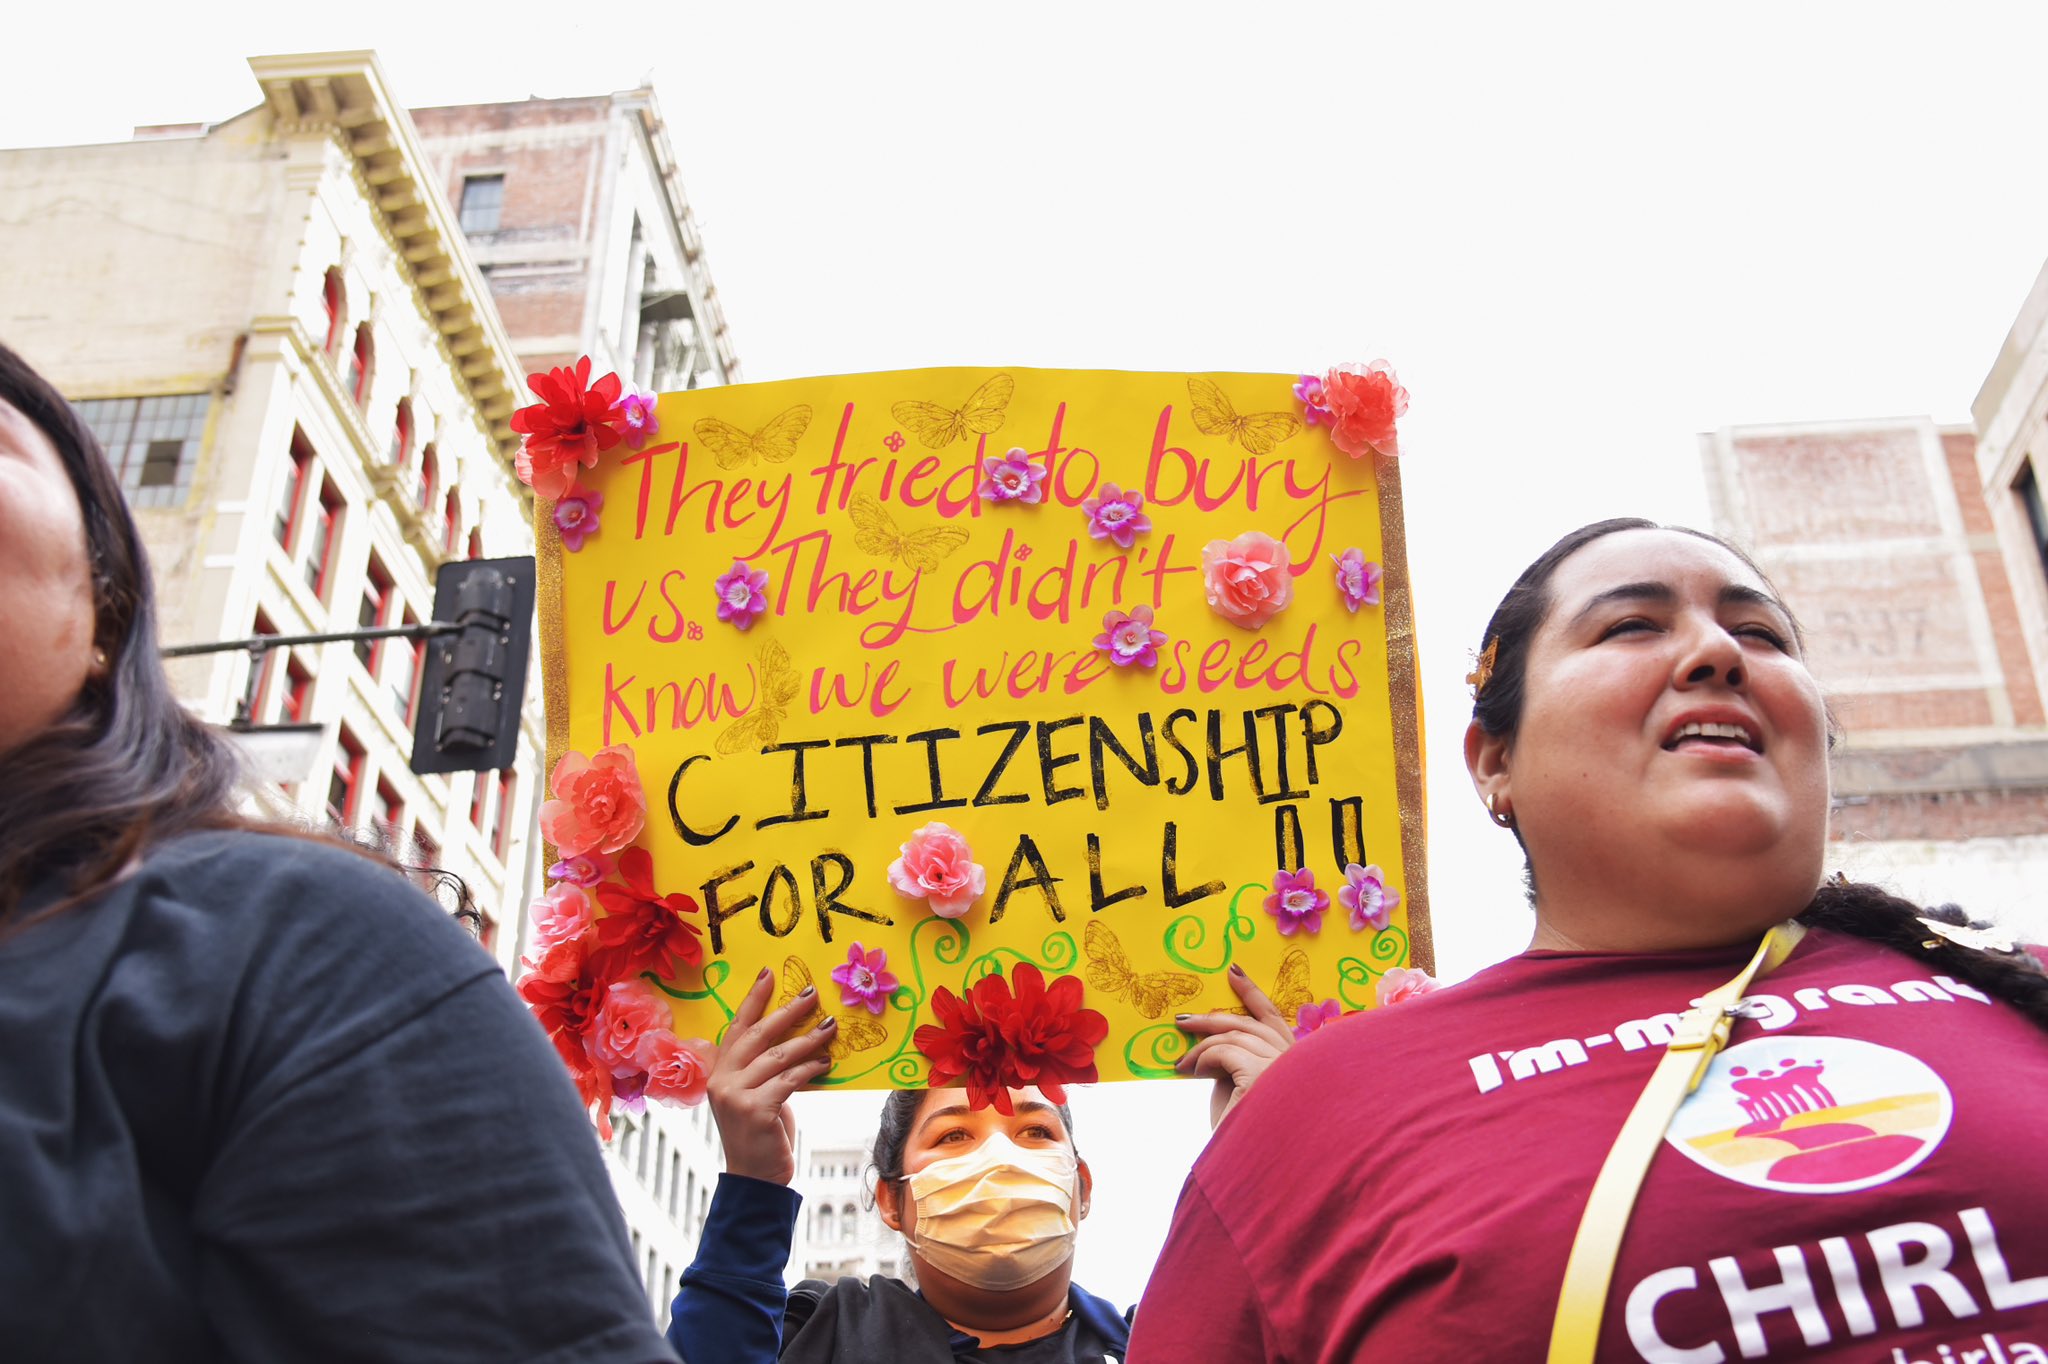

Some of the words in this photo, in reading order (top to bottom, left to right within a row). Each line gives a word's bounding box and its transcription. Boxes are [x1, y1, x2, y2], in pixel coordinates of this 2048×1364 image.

[620, 441, 793, 561] They
[810, 402, 987, 518] tried
[1033, 402, 1099, 501] to
[1145, 404, 1370, 577] bury
[770, 529, 957, 650] They
[953, 528, 1198, 625] didn't
[808, 660, 912, 718] we
[942, 649, 1109, 710] were
[1160, 623, 1361, 700] seeds
[668, 699, 1344, 847] CITIZENSHIP
[699, 850, 893, 954] FOR
[989, 821, 1227, 924] ALL
